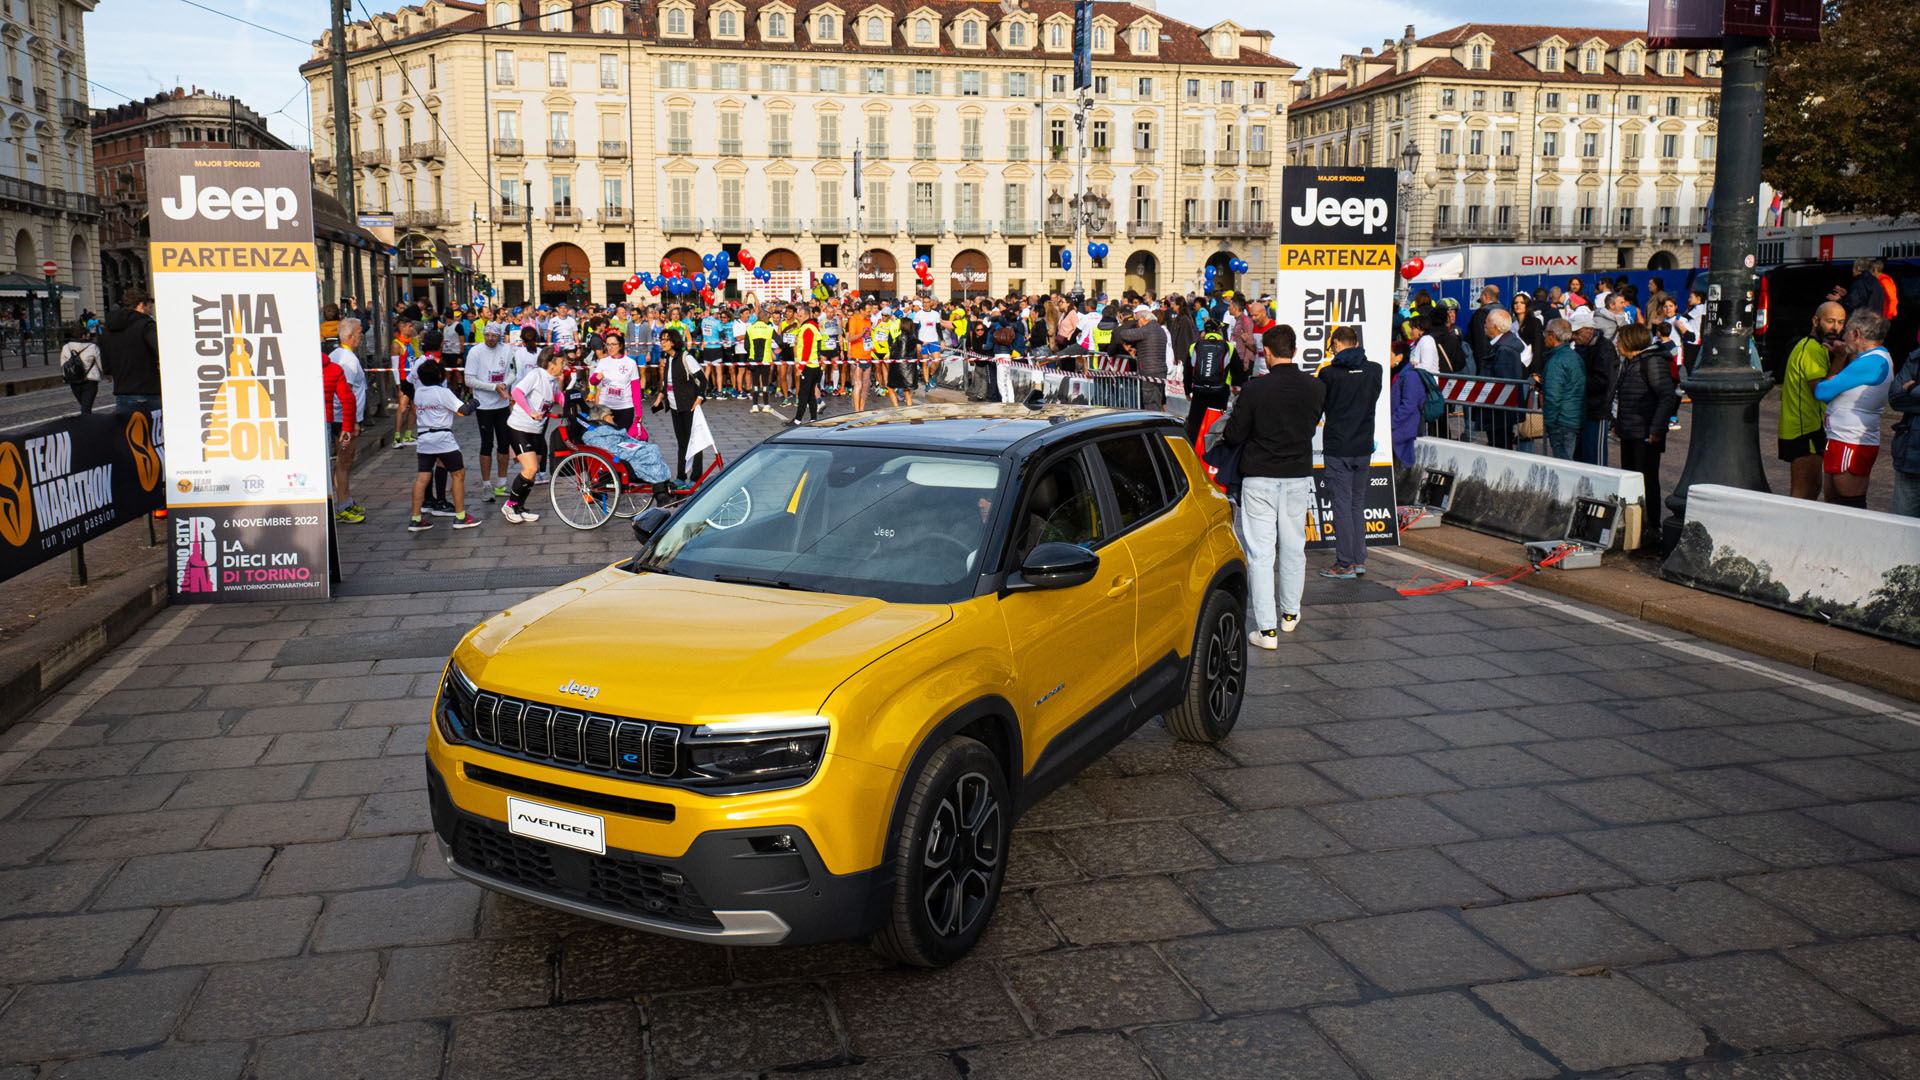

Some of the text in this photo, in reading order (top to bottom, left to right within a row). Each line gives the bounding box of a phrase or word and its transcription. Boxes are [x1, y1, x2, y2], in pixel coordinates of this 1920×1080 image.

[224, 160, 260, 168] SPONSOR
[161, 175, 298, 230] Jeep
[1290, 188, 1388, 234] Jeep
[162, 248, 310, 267] PARTENZA
[1287, 249, 1391, 266] PARTENZA
[1521, 256, 1578, 266] GIMAX
[1304, 289, 1325, 341] CITY
[192, 294, 224, 356] CITY
[197, 364, 231, 462] TORINO
[25, 431, 72, 484] TEAM
[194, 484, 230, 492] MARATHON
[242, 479, 264, 489] TRR
[32, 464, 112, 532] MARATHON
[42, 508, 116, 550] run your passion
[223, 516, 318, 528] 6 NOVEMBRE 2022
[874, 526, 896, 537] Jeep
[176, 518, 190, 593] TORINO CITY
[223, 540, 243, 552] LA
[223, 553, 298, 568] DIECI KM
[224, 568, 310, 583] DI TORINO
[224, 581, 320, 591] WWW.TORINOCITYMARATHON.IT
[558, 679, 599, 700] Jeep
[517, 814, 595, 837] AVENGER
